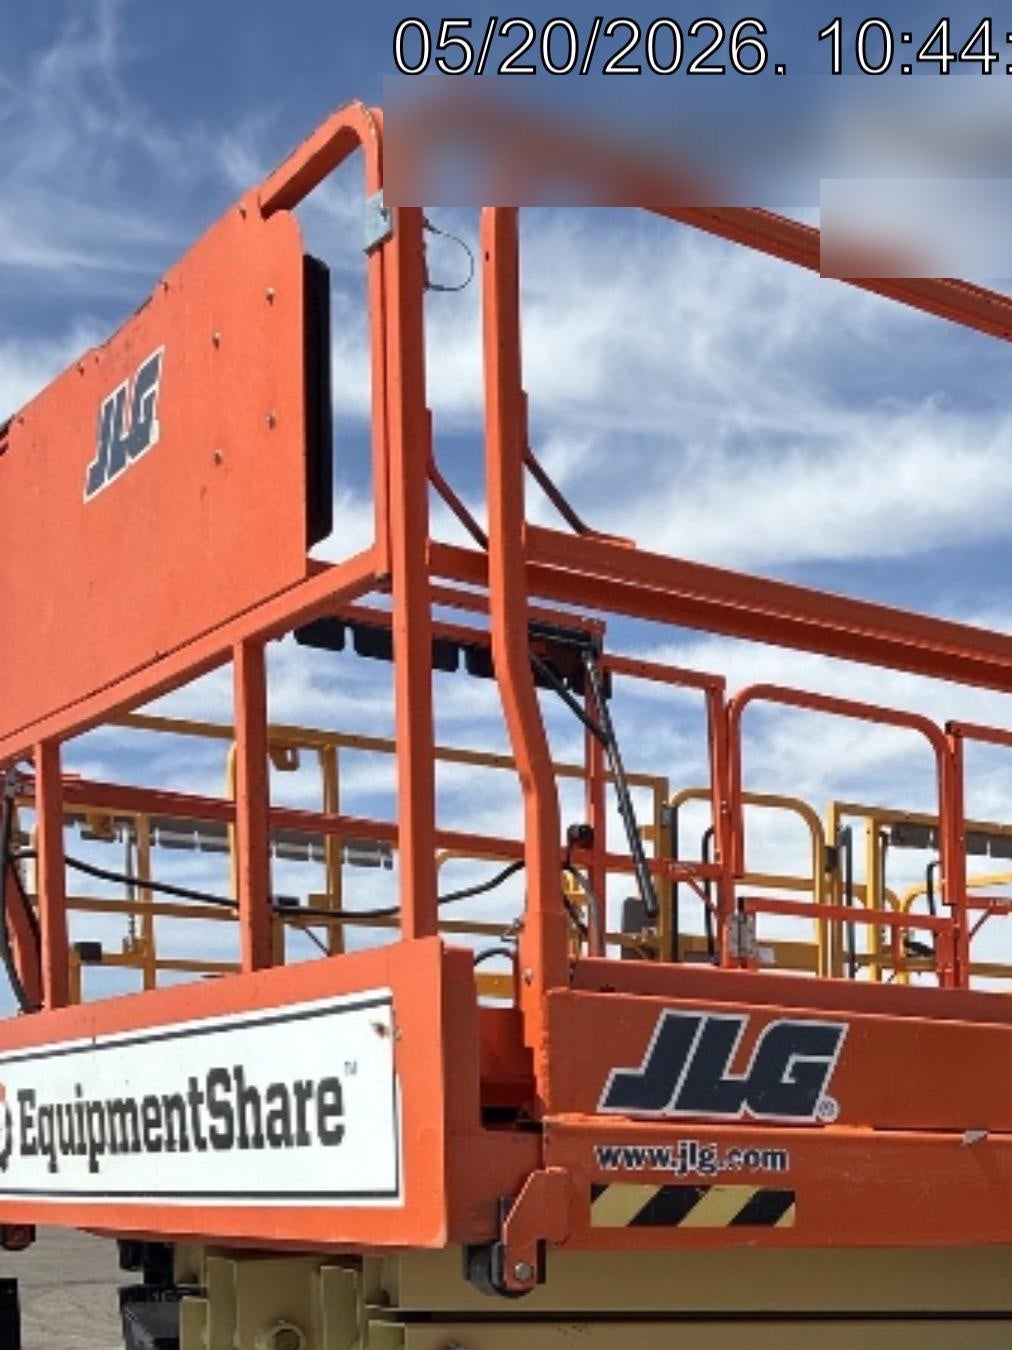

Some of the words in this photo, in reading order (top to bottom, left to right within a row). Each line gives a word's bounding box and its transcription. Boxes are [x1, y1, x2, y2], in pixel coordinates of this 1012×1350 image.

[83, 344, 165, 503] JLG
[17, 1065, 345, 1173] EquipmentShare
[596, 1008, 849, 1123] JLG
[594, 1140, 790, 1176] www.jlg.com
